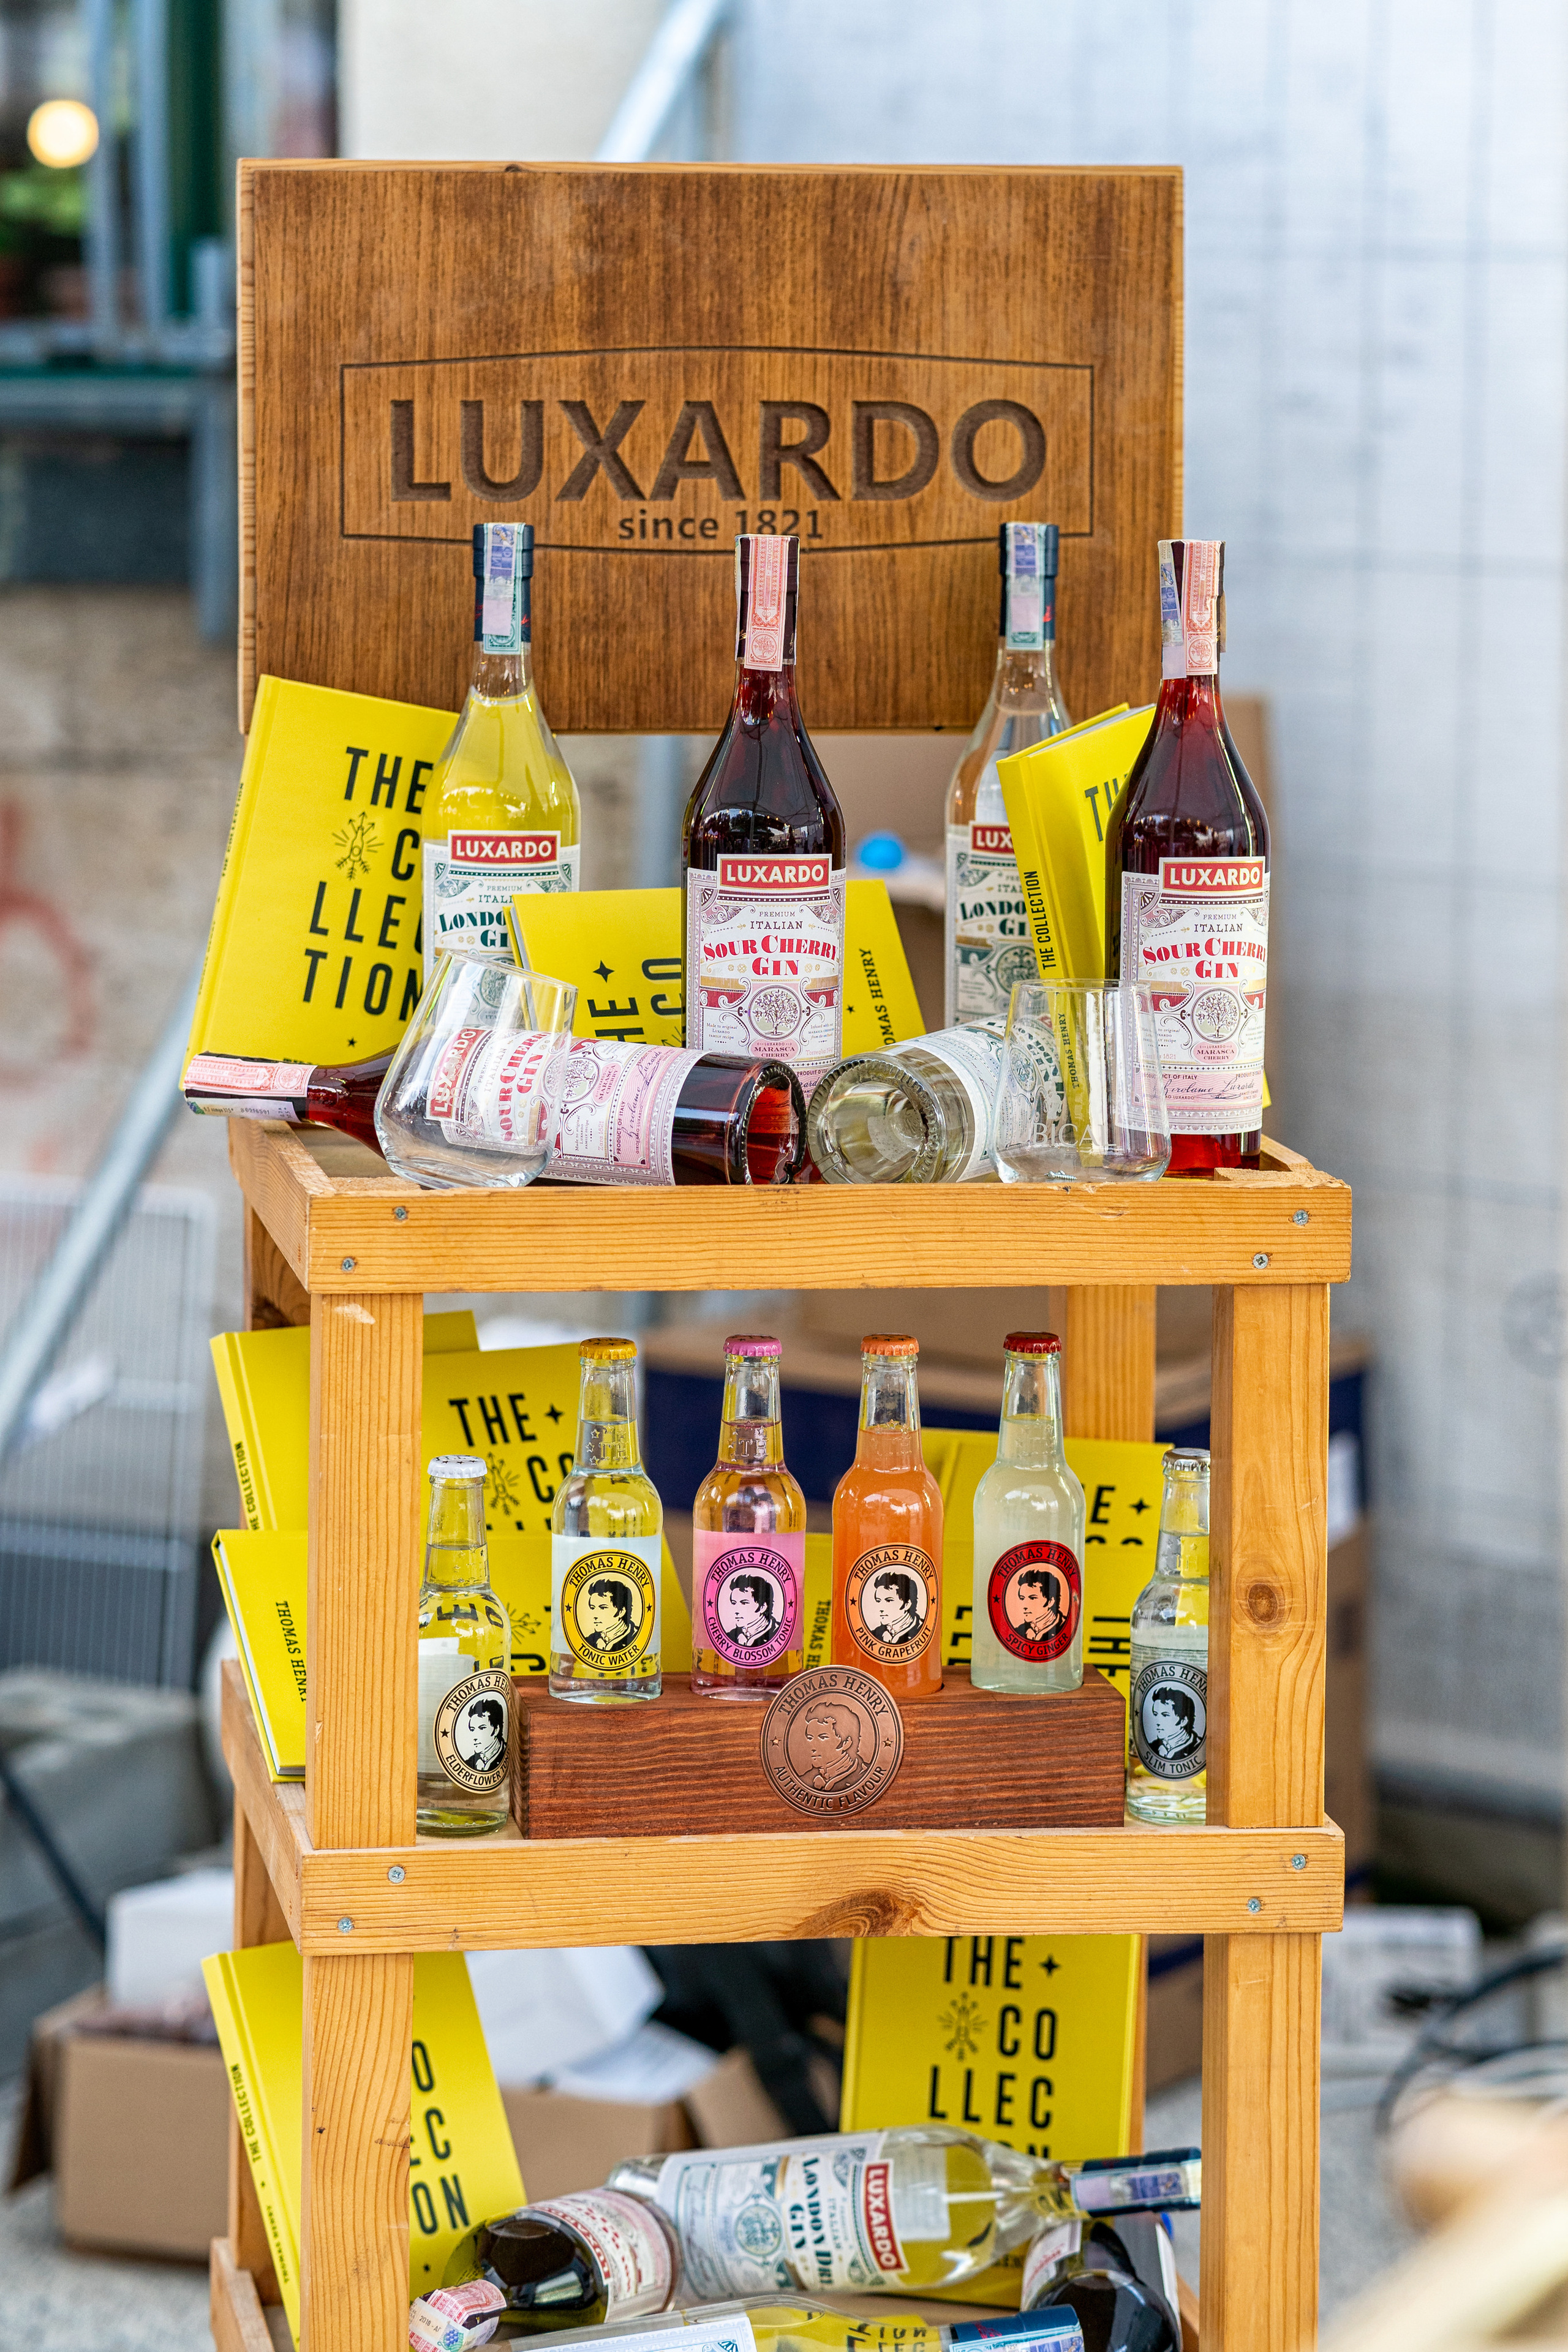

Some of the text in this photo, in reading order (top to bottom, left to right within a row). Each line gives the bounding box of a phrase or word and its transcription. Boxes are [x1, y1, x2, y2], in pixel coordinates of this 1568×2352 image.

[390, 399, 1047, 502] LUXARDO
[618, 510, 823, 540] since 1821
[344, 746, 434, 815] THE
[391, 828, 420, 881] C
[456, 839, 552, 859] LUXARDO
[726, 864, 825, 884] LUXARDO
[1169, 866, 1261, 886] LUXARDO
[478, 894, 513, 903] ITALI
[959, 900, 1027, 921] LONDO
[309, 881, 423, 955] LLE
[439, 910, 507, 933] LONDO
[750, 920, 803, 930] ITALIAN
[998, 919, 1027, 936] GI
[1023, 870, 1057, 970] THE COLLECTION
[1194, 923, 1243, 933] ITALIAN
[480, 929, 510, 948] GI
[702, 938, 758, 963] SOUR
[1142, 941, 1202, 966] SOUR
[752, 957, 800, 976] GIN
[1195, 960, 1240, 979] GIN
[859, 948, 897, 1046] OMAS HENRY
[1057, 1013, 1080, 1088] THOMAS HENRY
[516, 1053, 544, 1095] GIN
[598, 1065, 616, 1101] MARASCA
[605, 1069, 618, 1095] CHERRY
[617, 1117, 622, 1126] OF
[448, 1392, 538, 1448] THE
[234, 1441, 257, 1515] COLLECTION
[569, 1556, 650, 1589] THOMAS HENRY
[710, 1551, 792, 1584] THOMAS HENRY
[854, 1550, 934, 1582] THOMAS HENRY
[997, 1547, 1077, 1580] THOMAS HENRY
[276, 1600, 301, 1656] THOMAS
[707, 1616, 793, 1661] CHERRY BLOSSOM TONIC
[809, 1599, 832, 1650] THOMAS
[578, 1643, 640, 1666] TONIC WATER
[855, 1626, 877, 1651] PINK
[878, 1626, 932, 1658] GRAPEFRUIT
[1005, 1632, 1069, 1656] SPICY GINGER
[445, 1676, 491, 1713] THOMAS
[777, 1673, 889, 1717] THOMAS HENRY
[1136, 1665, 1208, 1699] THOMAS HENR
[445, 1754, 502, 1786] ELDERFLOWER
[1144, 1751, 1202, 1774] SLIM TONIC
[774, 1765, 888, 1811] AUTHENTIC FLAVOUR
[942, 1936, 1025, 1990] THE
[998, 2003, 1058, 2061] CO
[230, 2062, 262, 2164] THE COLLECTION
[928, 2064, 1055, 2130] LLEC
[411, 2173, 471, 2236] ON
[802, 2157, 825, 2245] LONDON
[867, 2167, 898, 2267] LUXARDO
[419, 2315, 431, 2326] 2018
